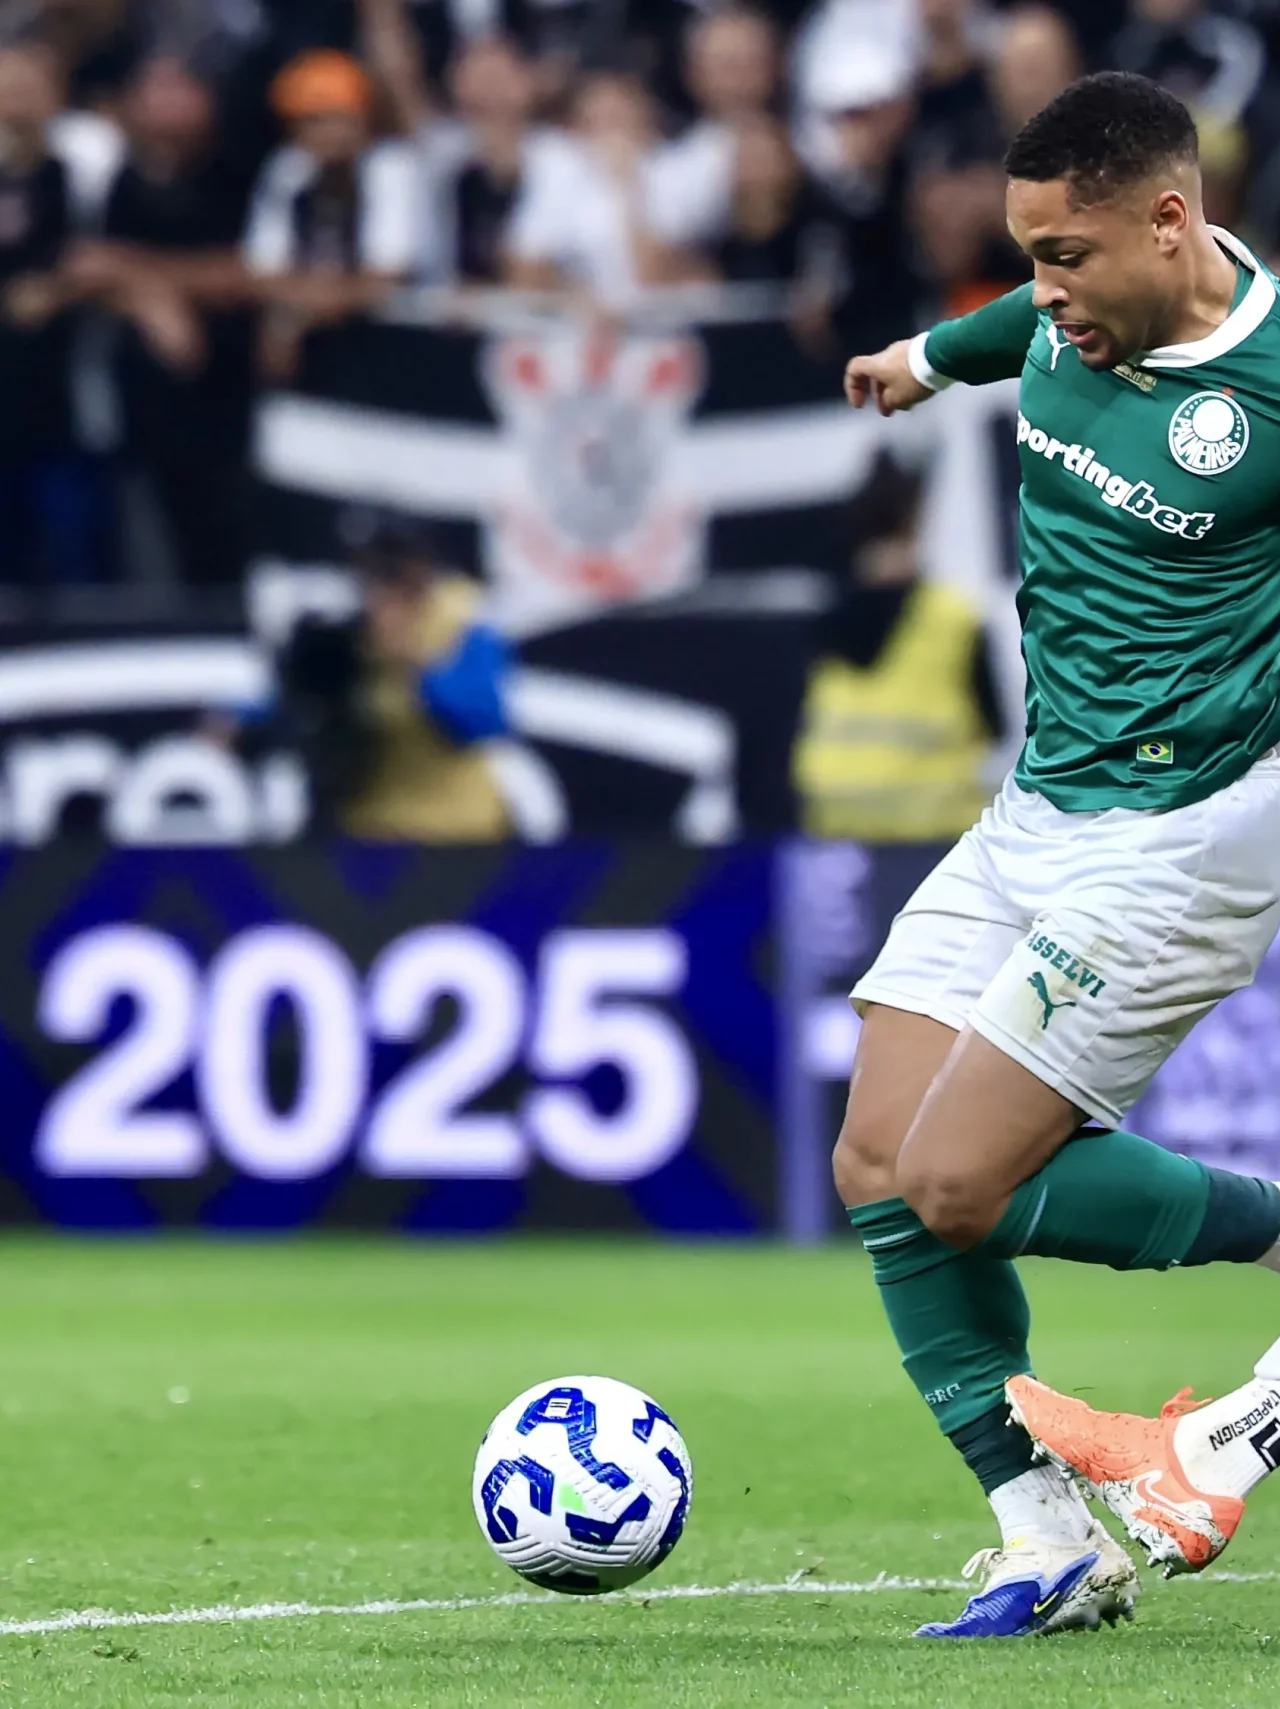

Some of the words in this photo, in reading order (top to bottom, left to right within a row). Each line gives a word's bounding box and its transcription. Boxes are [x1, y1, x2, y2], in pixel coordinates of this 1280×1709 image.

[1016, 410, 1216, 540] portingbet
[1172, 416, 1242, 470] PALMEIRAS
[36, 923, 698, 1182] 2025
